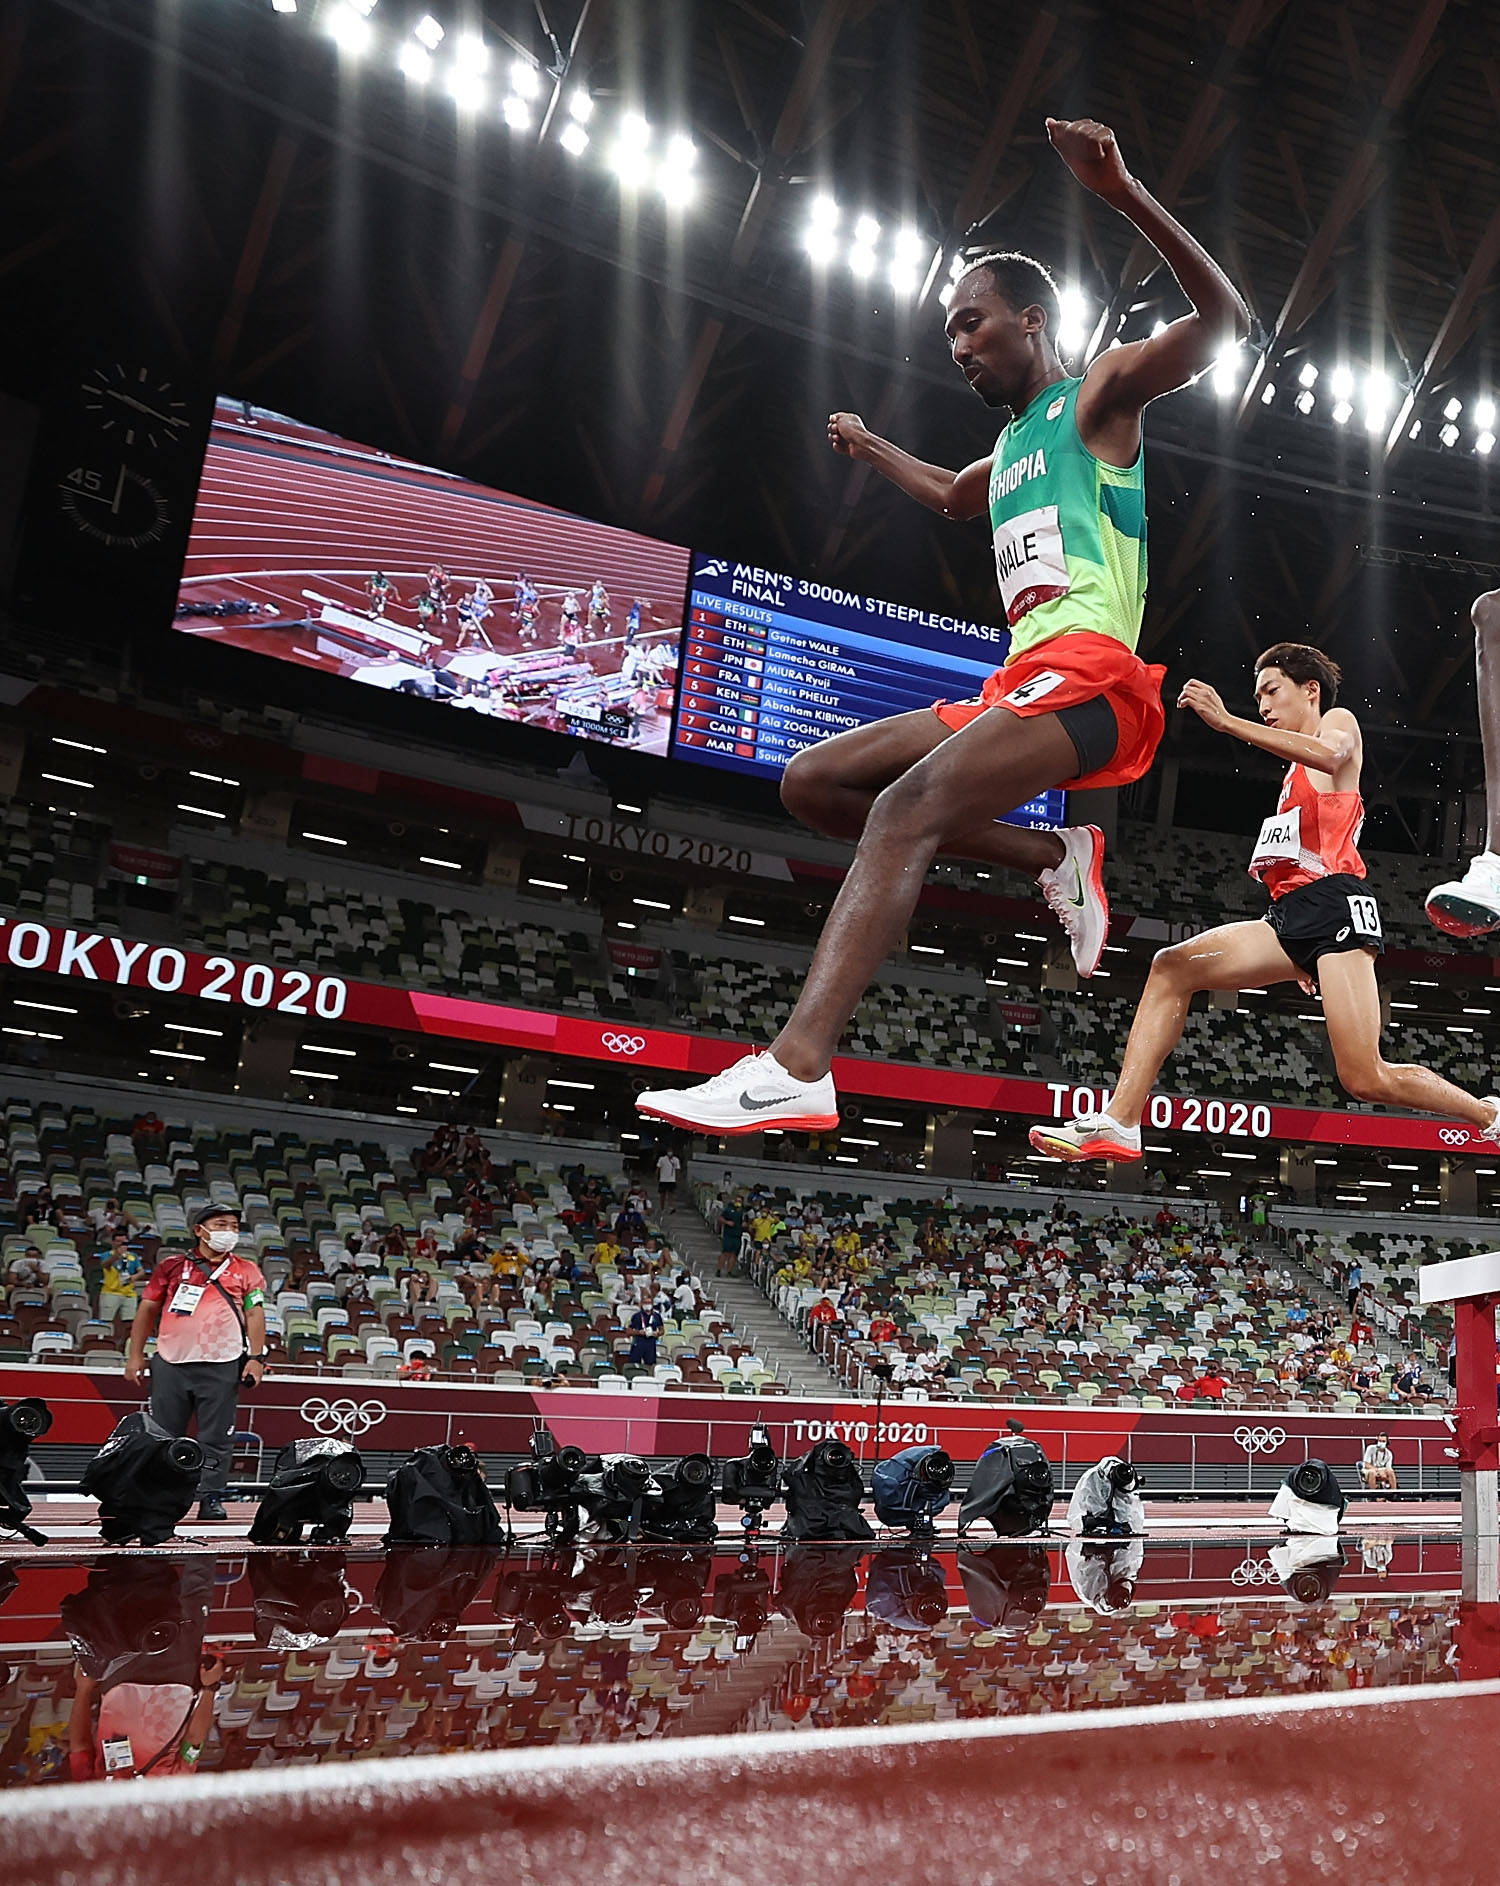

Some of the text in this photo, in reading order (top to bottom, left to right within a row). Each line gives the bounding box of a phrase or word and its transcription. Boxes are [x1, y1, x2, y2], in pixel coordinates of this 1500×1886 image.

[67, 467, 103, 491] 45
[996, 532, 1038, 582] WALE
[696, 595, 773, 623] LIVE RESULTS
[732, 579, 786, 607] FINAL
[733, 563, 793, 591] MEN'S
[798, 580, 861, 609] 3000M
[865, 598, 1000, 642] STEEPLECHASE
[697, 629, 856, 676] 2 ETH Lamecha GIRMA
[699, 613, 839, 656] 1 ETH Getnet WALE
[693, 664, 840, 706] 4 FRA Alexis PHELUT
[695, 645, 831, 689] 2 JPN MIURA Ryuji
[691, 681, 861, 728] 5 KEN Abraham KIBIWOT
[1013, 676, 1052, 700] 4
[689, 697, 697, 707] 6
[719, 705, 738, 718] ITA
[761, 716, 780, 728] Ala
[685, 733, 694, 742] 7
[706, 739, 734, 752] MAR
[687, 716, 696, 725] 7
[709, 721, 736, 735] CAN
[760, 733, 784, 747] John
[1024, 804, 1045, 814] +1.0
[564, 812, 752, 874] TOKYO 2020
[1353, 899, 1378, 932] 13
[0, 917, 347, 1020] OKYO 2020
[1047, 1082, 1271, 1138] TOO 2020
[793, 1420, 927, 1443] TOKYO 2020
